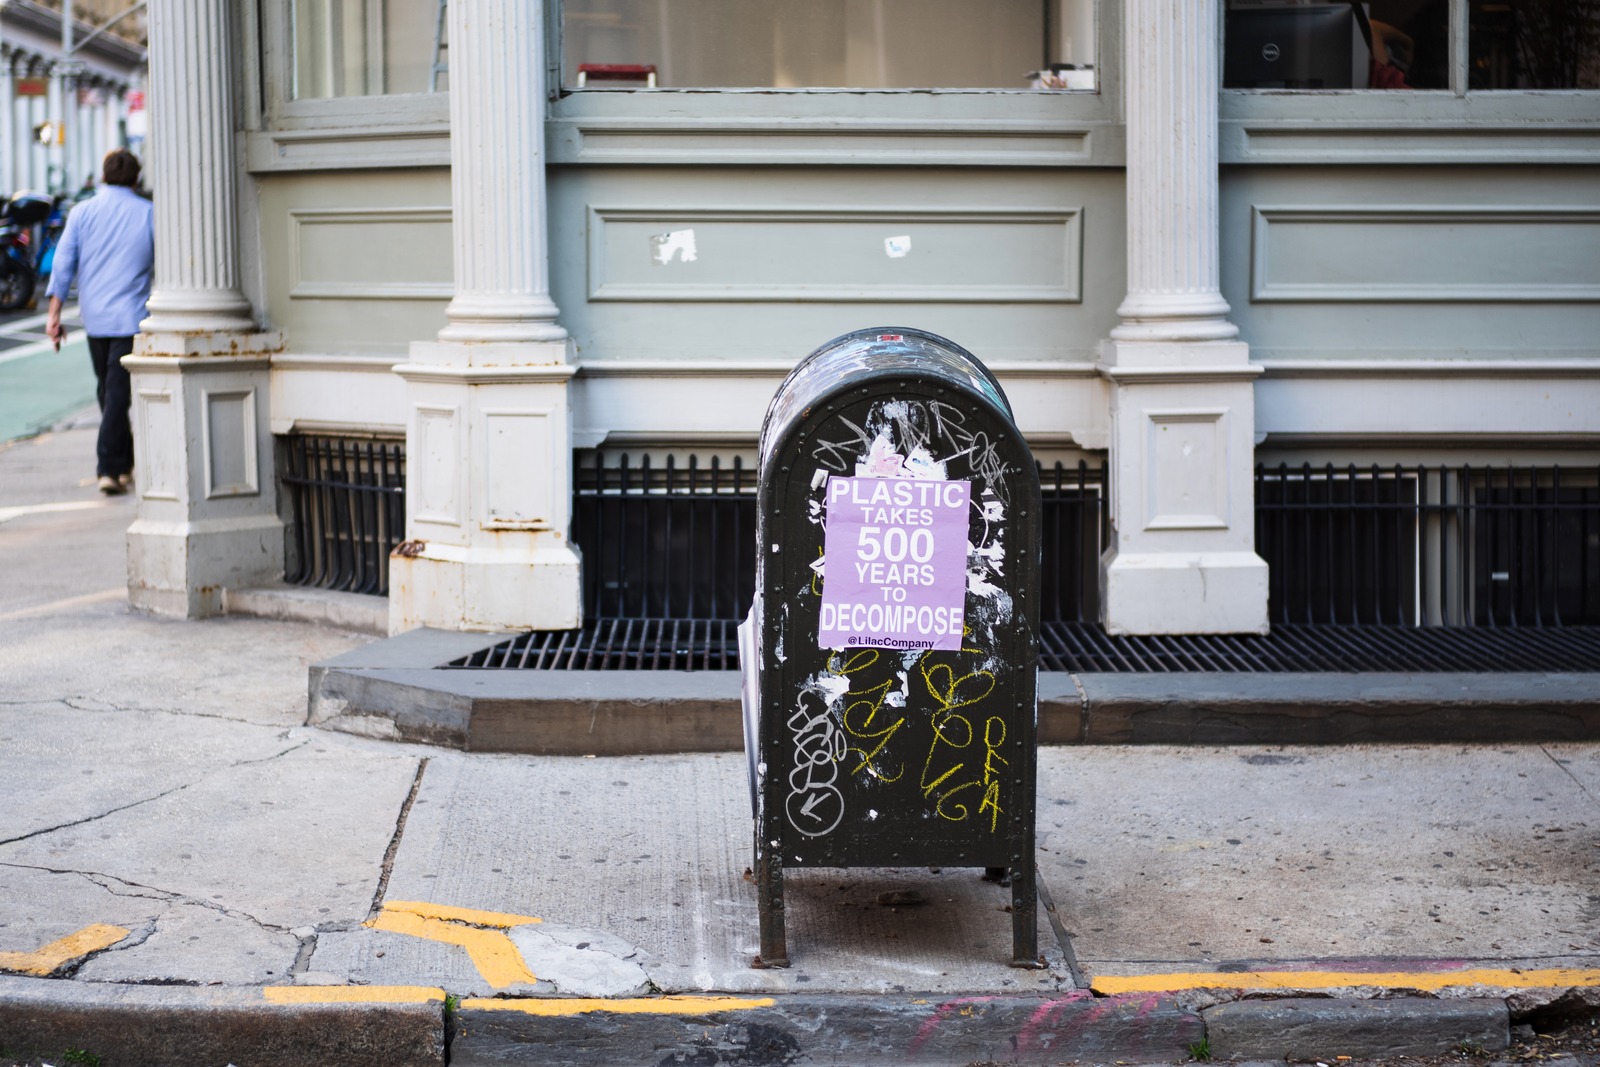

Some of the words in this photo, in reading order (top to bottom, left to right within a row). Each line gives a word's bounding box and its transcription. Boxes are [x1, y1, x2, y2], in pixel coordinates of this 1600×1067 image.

[831, 480, 964, 508] PLASTIC
[860, 507, 934, 526] TAKES
[856, 526, 935, 563] 500
[855, 562, 935, 586] YEARS
[880, 587, 907, 602] TO
[821, 603, 963, 635] DECOMPOSE
[848, 636, 935, 649] @LilacCompany
